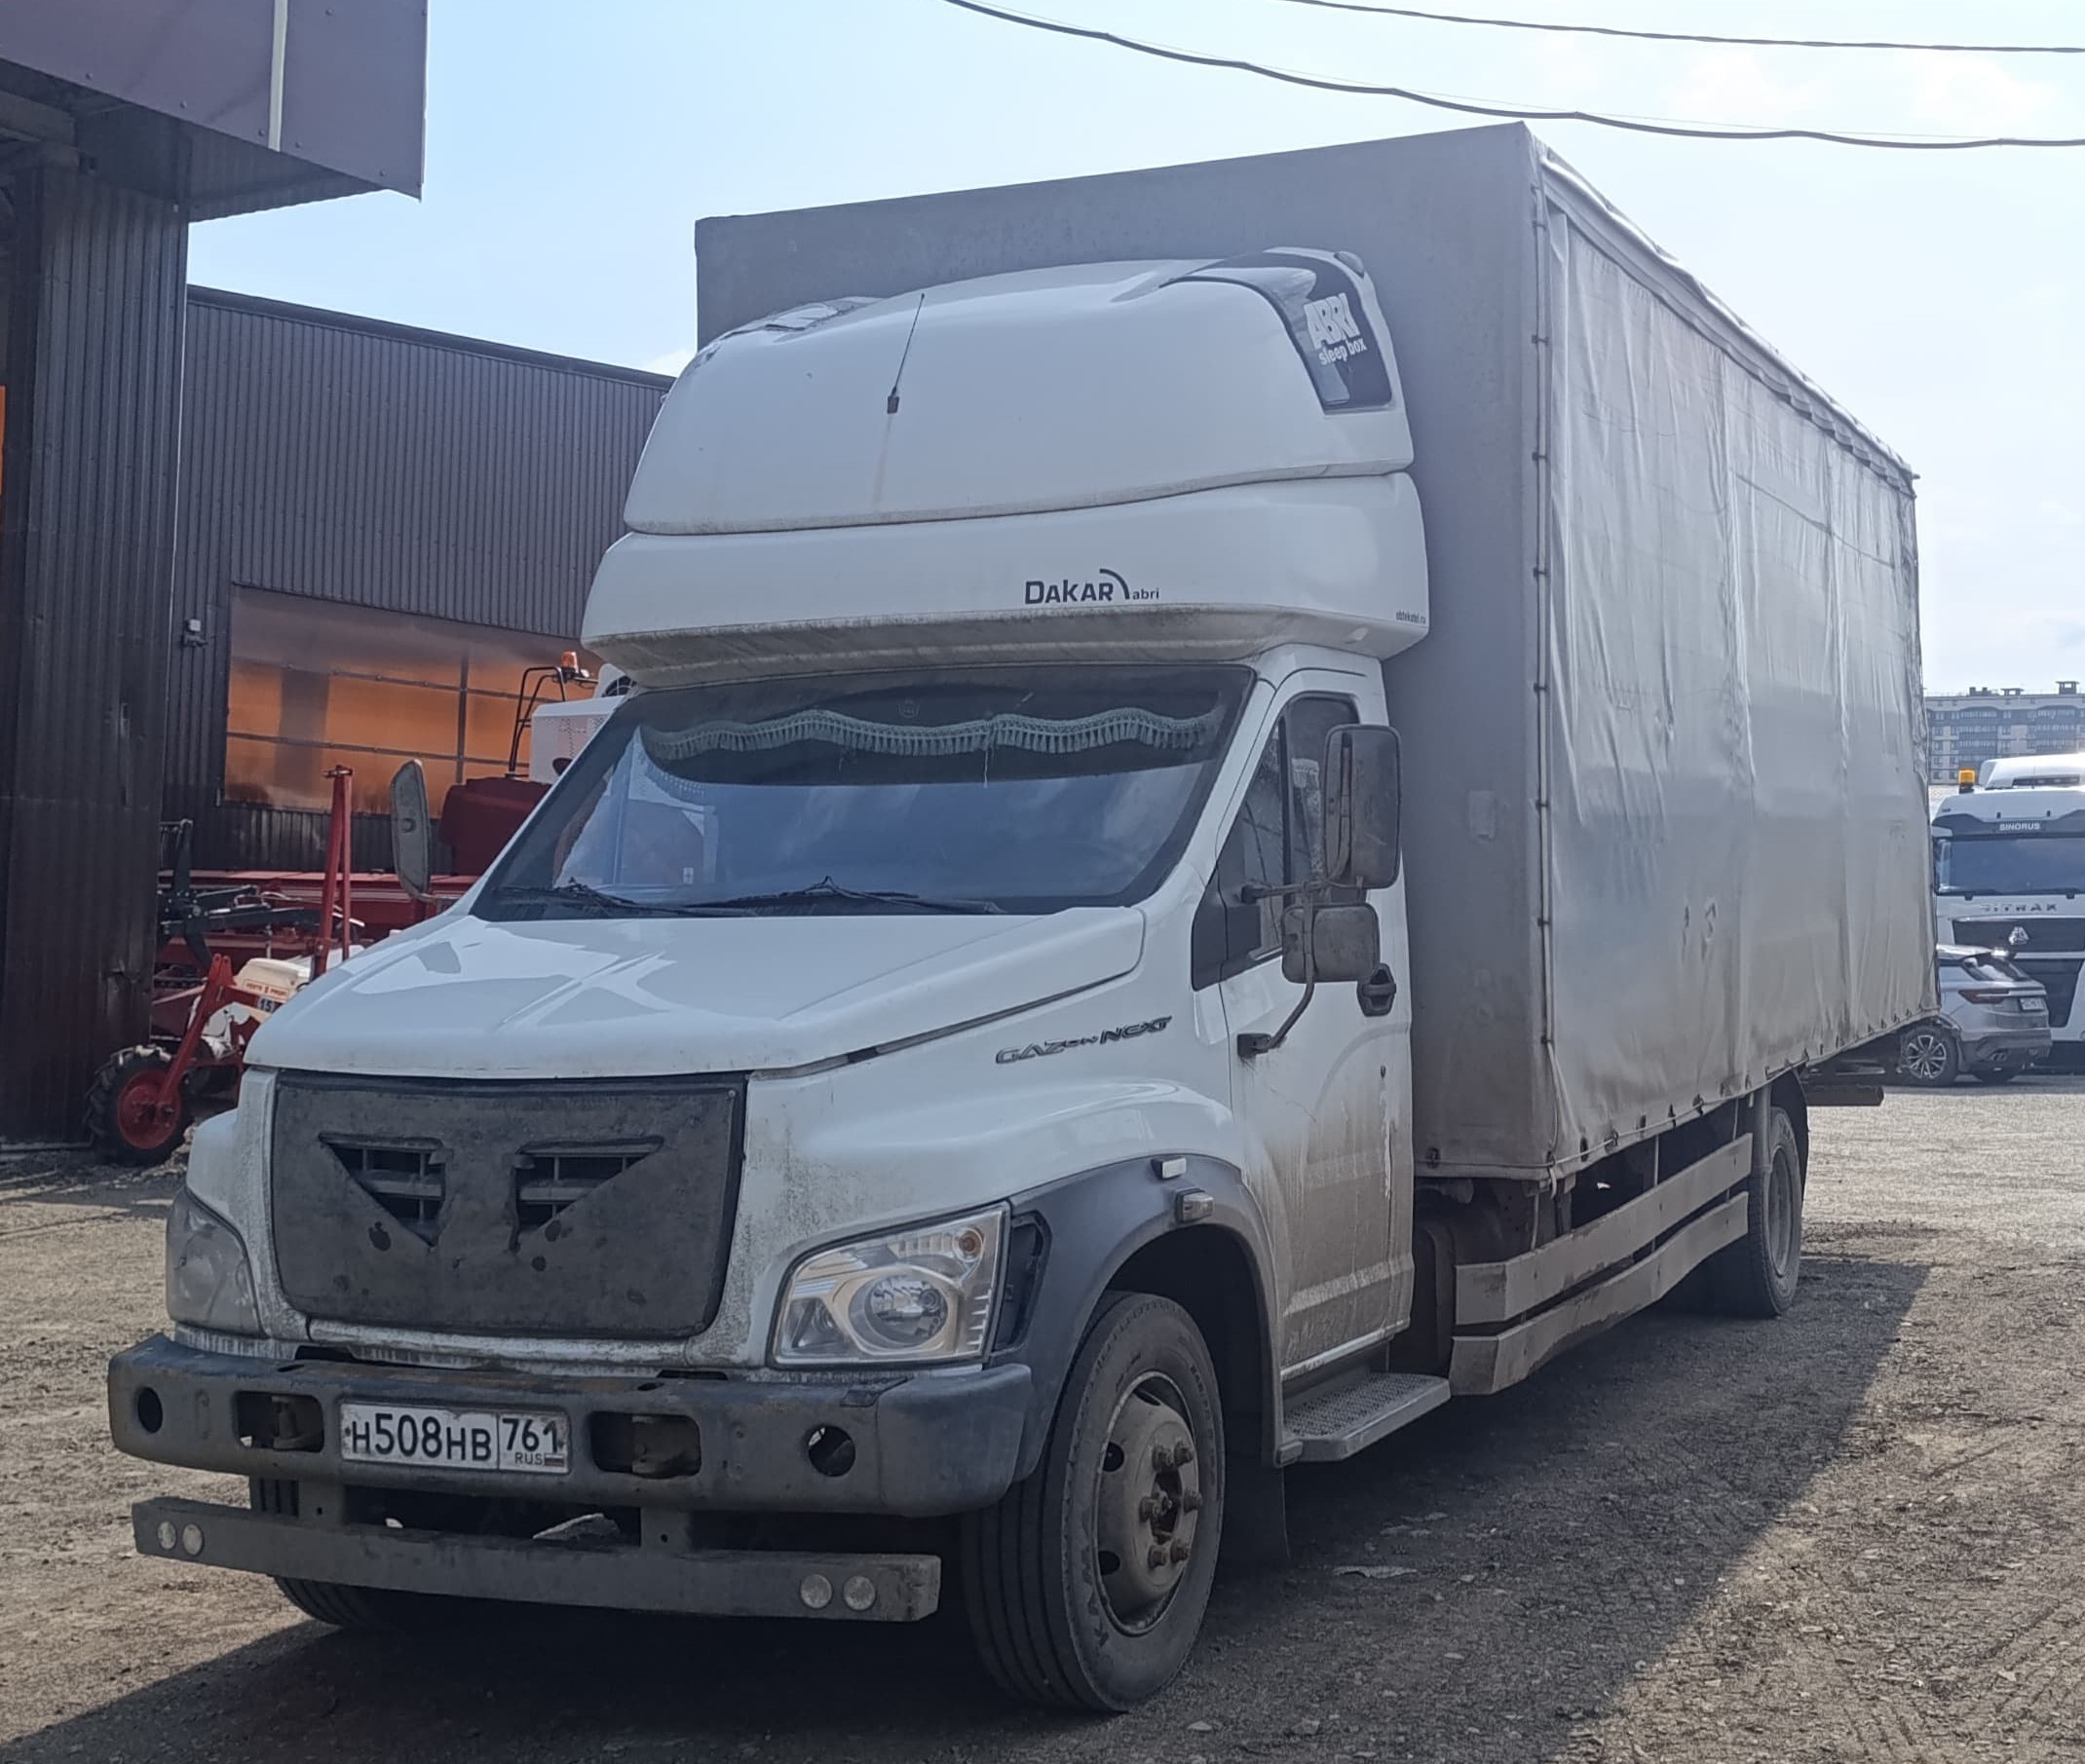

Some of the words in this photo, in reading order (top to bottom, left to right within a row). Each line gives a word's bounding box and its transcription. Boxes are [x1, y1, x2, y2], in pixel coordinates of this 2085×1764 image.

[1304, 292, 1361, 351] ABRI
[1318, 346, 1348, 365] sleep
[1346, 338, 1368, 356] box
[1132, 586, 1159, 600] abri
[1100, 1015, 1173, 1045] NEXT
[502, 1417, 558, 1453] 761
[514, 1452, 543, 1465] RUS
